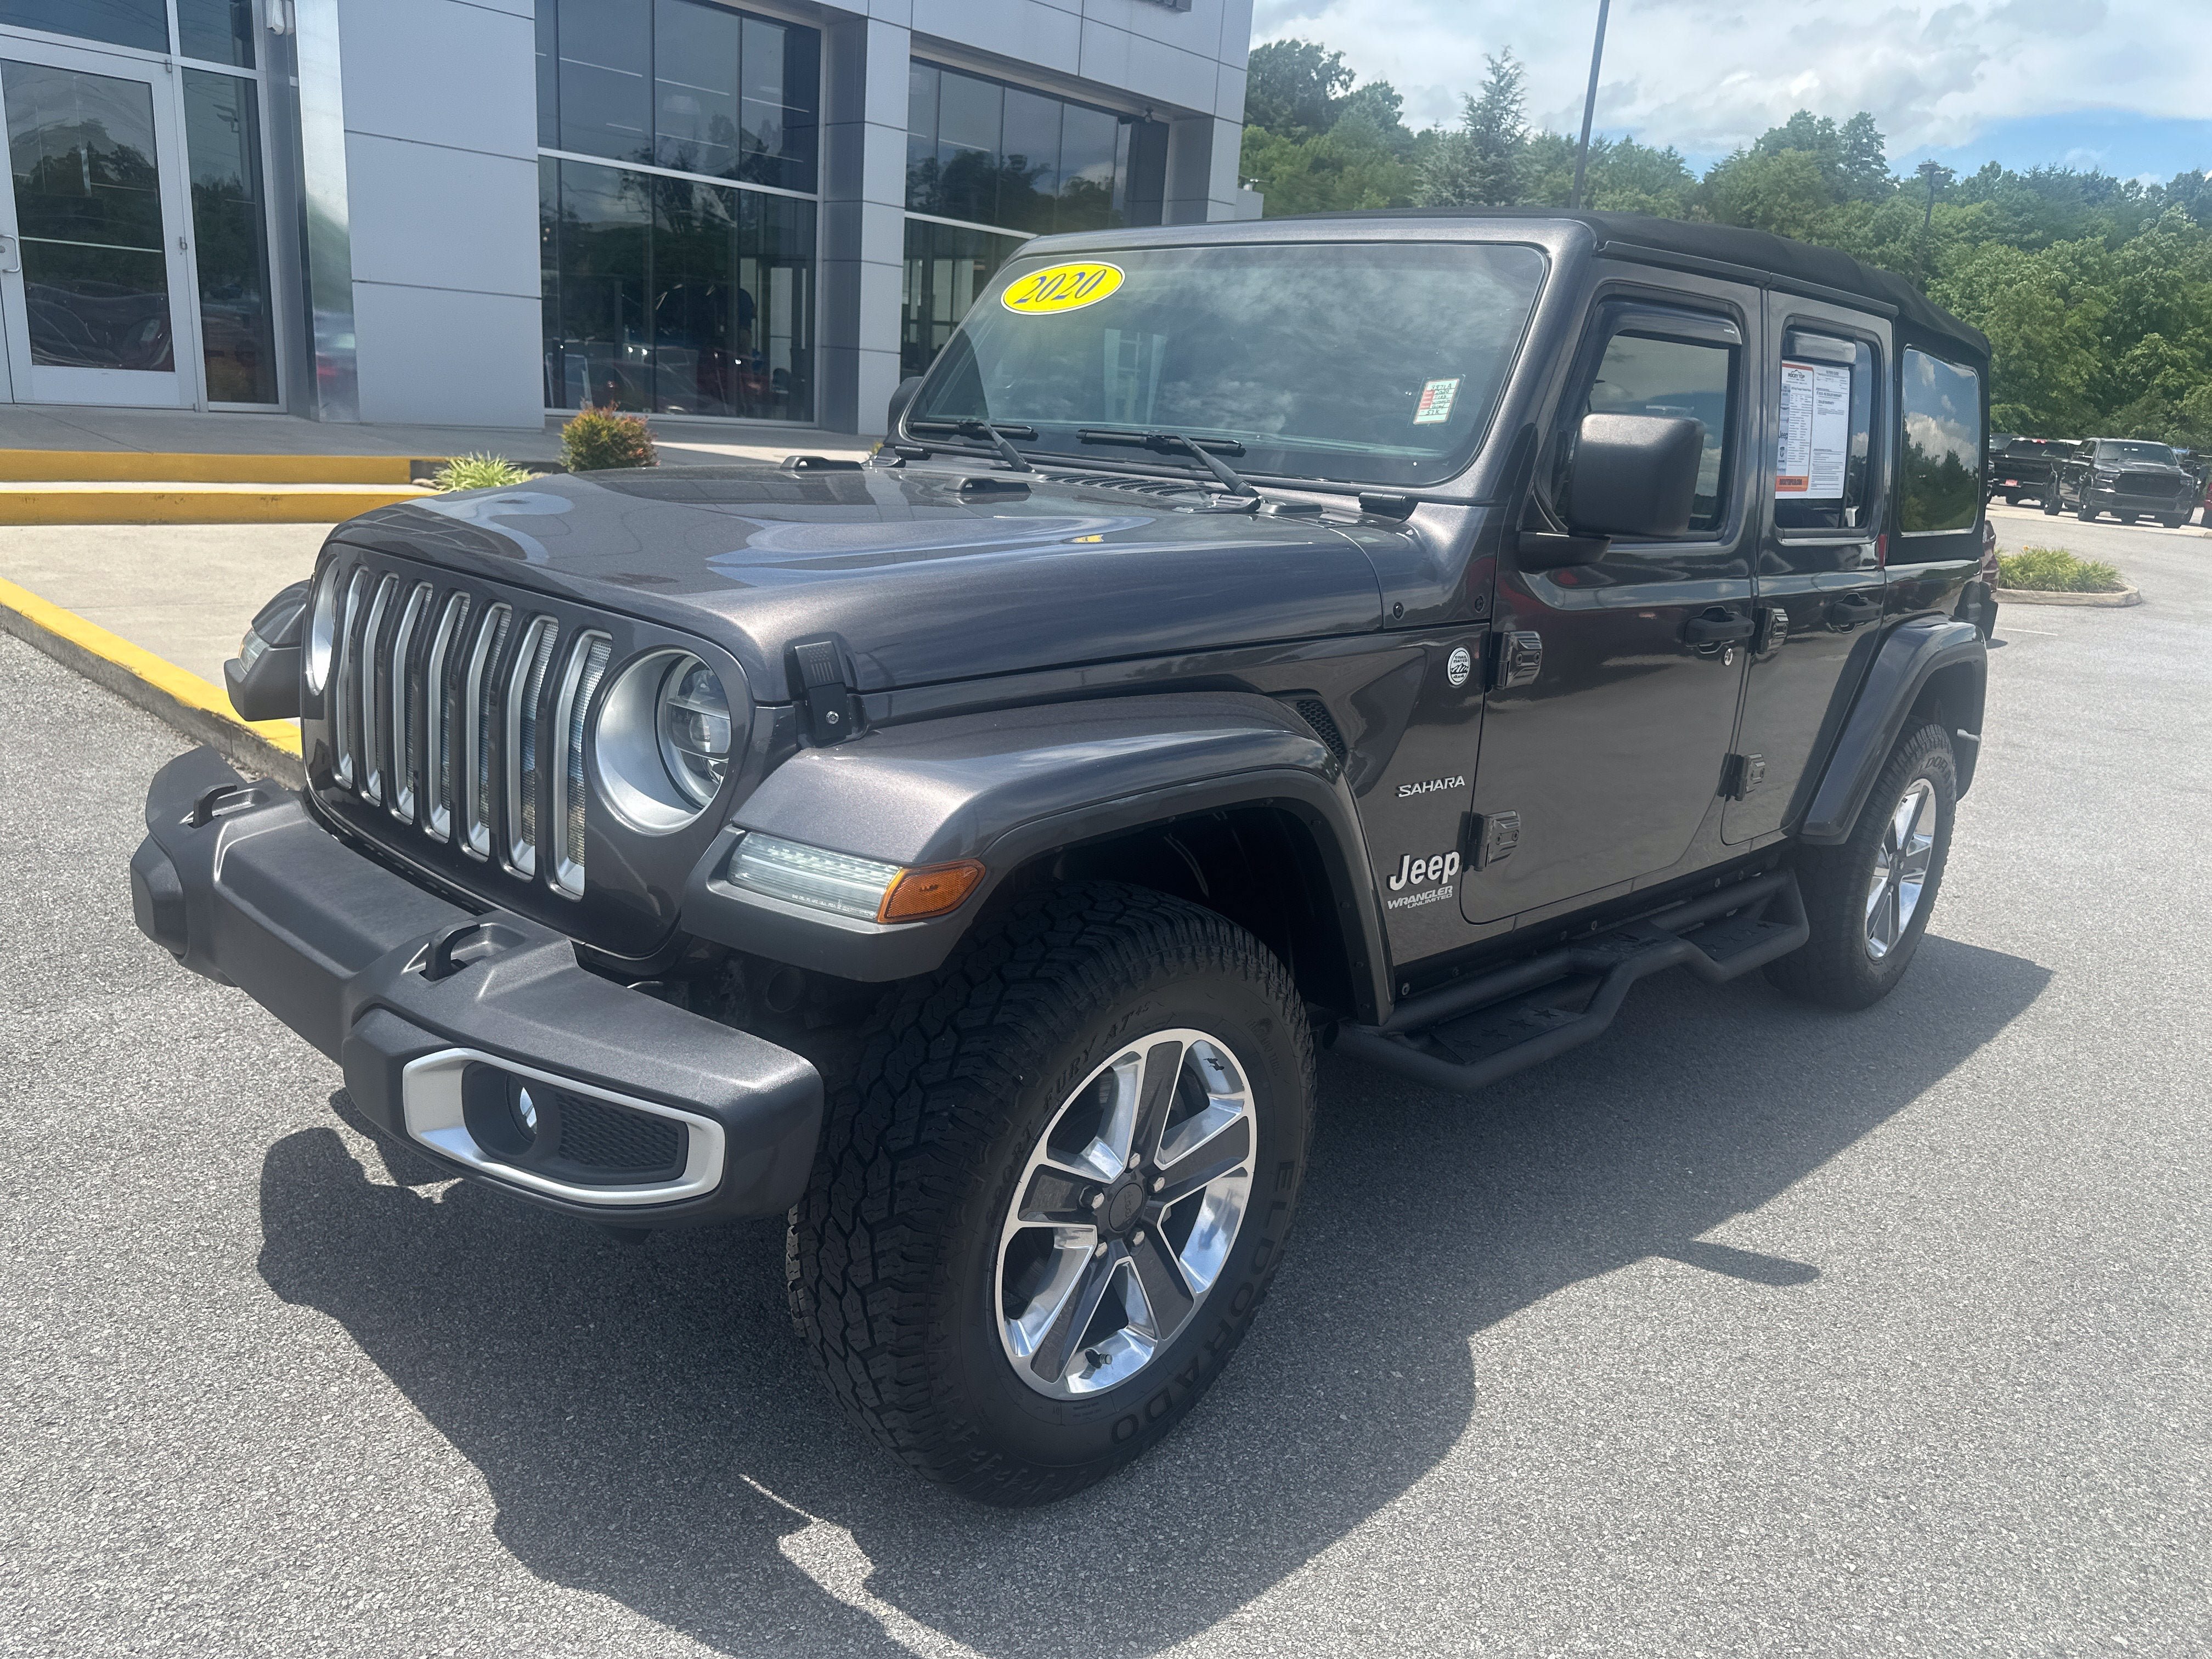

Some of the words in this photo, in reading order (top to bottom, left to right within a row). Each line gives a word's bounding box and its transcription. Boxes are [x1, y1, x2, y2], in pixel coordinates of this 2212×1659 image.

[1013, 269, 1107, 304] 2020
[1397, 775, 1465, 798] SAHARA
[1389, 850, 1459, 891] Jeep
[1387, 885, 1453, 909] WRANGLER
[1407, 893, 1453, 909] UNLIMITED
[1111, 1160, 1295, 1444] ELDORADO
